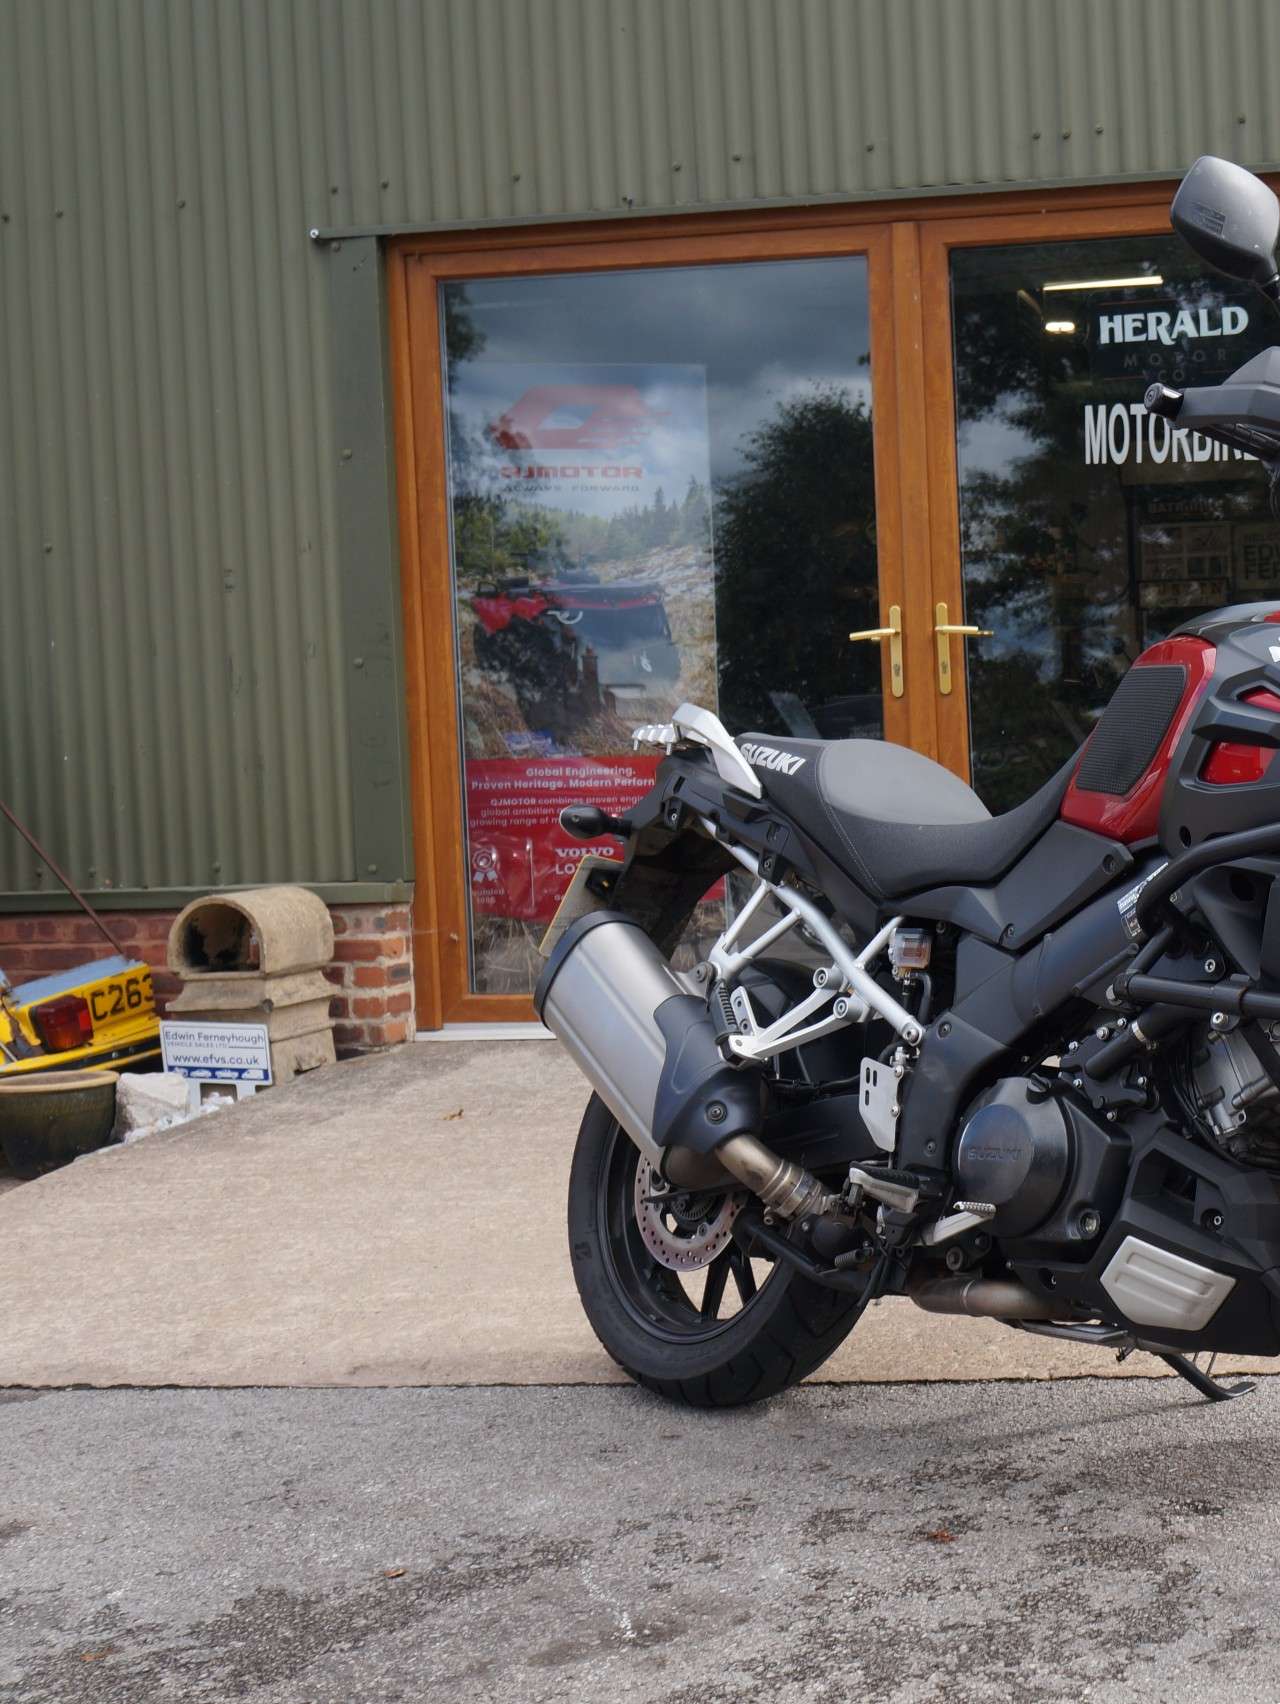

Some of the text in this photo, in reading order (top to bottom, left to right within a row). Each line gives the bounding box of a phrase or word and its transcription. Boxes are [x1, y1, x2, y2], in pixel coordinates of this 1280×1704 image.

[1100, 306, 1249, 346] HERALD
[740, 743, 807, 776] SUZUKI
[526, 766, 636, 778] Global Engineering.
[472, 781, 511, 790] Proven
[514, 779, 567, 791] Heritage.
[569, 778, 611, 788] Modern
[510, 817, 537, 827] range
[555, 847, 614, 859] VOLVO
[165, 1031, 264, 1045] Edwin Ferneyhough
[173, 1053, 259, 1065] www.efvs.co.uk
